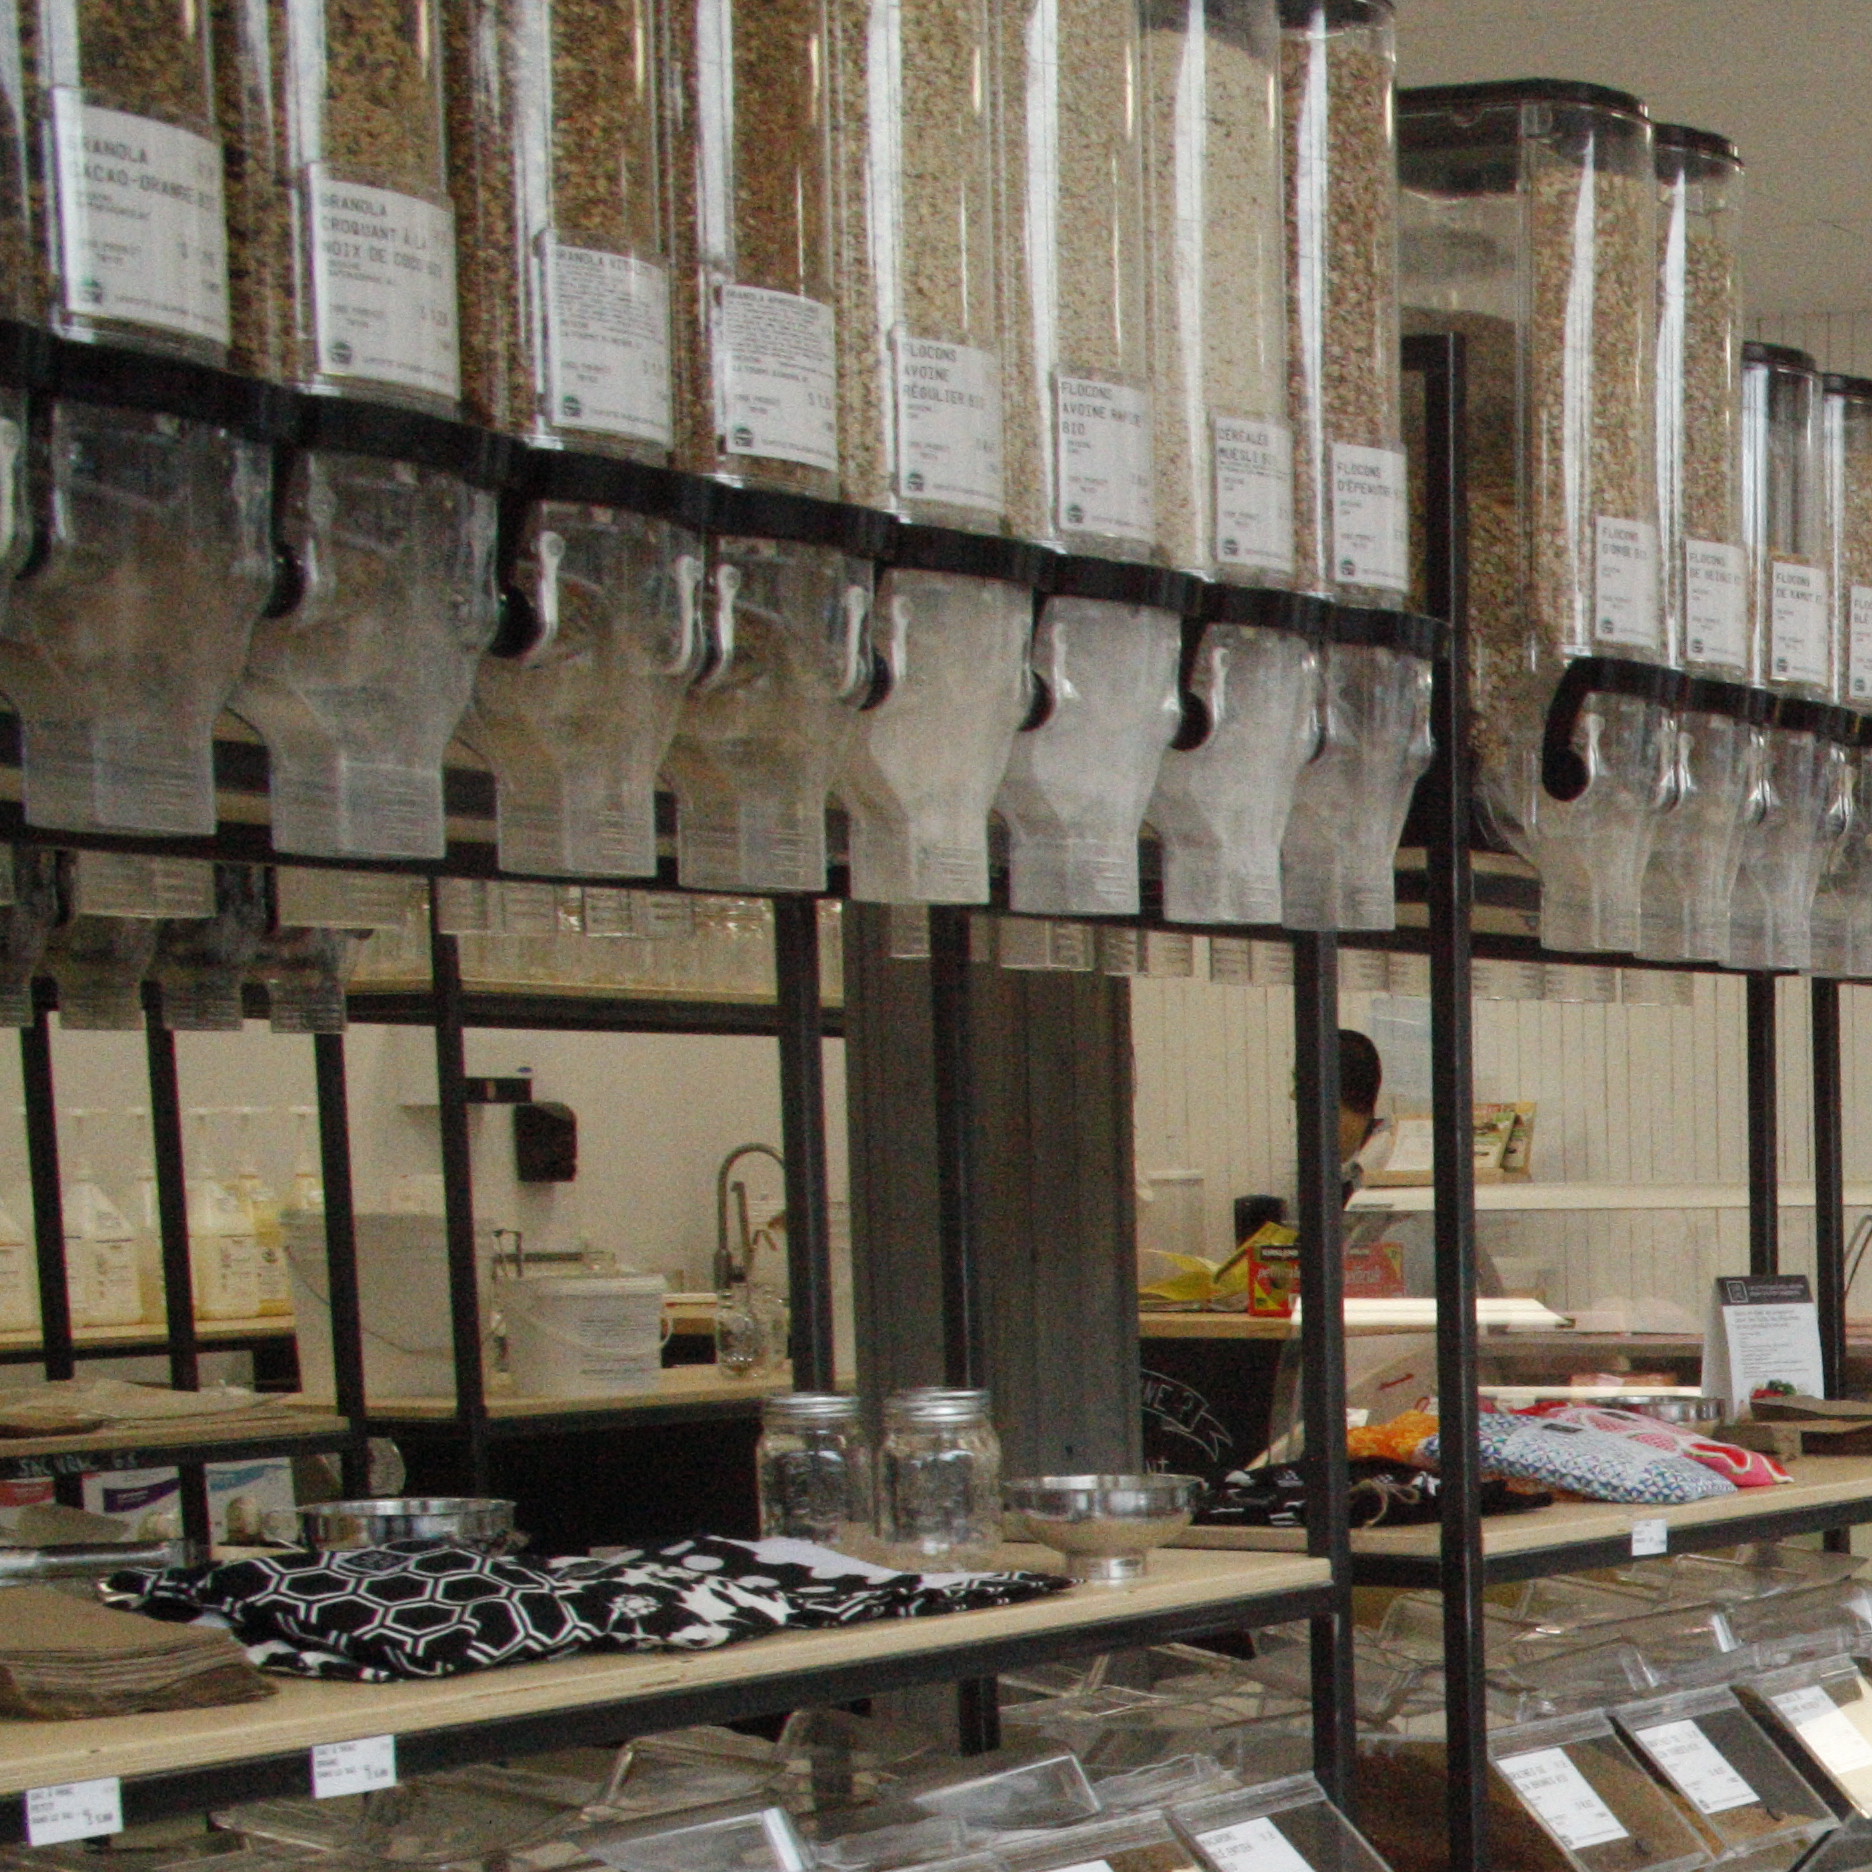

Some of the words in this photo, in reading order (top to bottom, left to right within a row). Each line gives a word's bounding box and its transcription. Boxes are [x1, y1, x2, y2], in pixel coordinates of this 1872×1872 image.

[903, 366, 950, 383] AVOINE
[1060, 381, 1113, 400] FLOCONS
[1061, 403, 1107, 422] AVOINE
[1061, 422, 1086, 437] BIO
